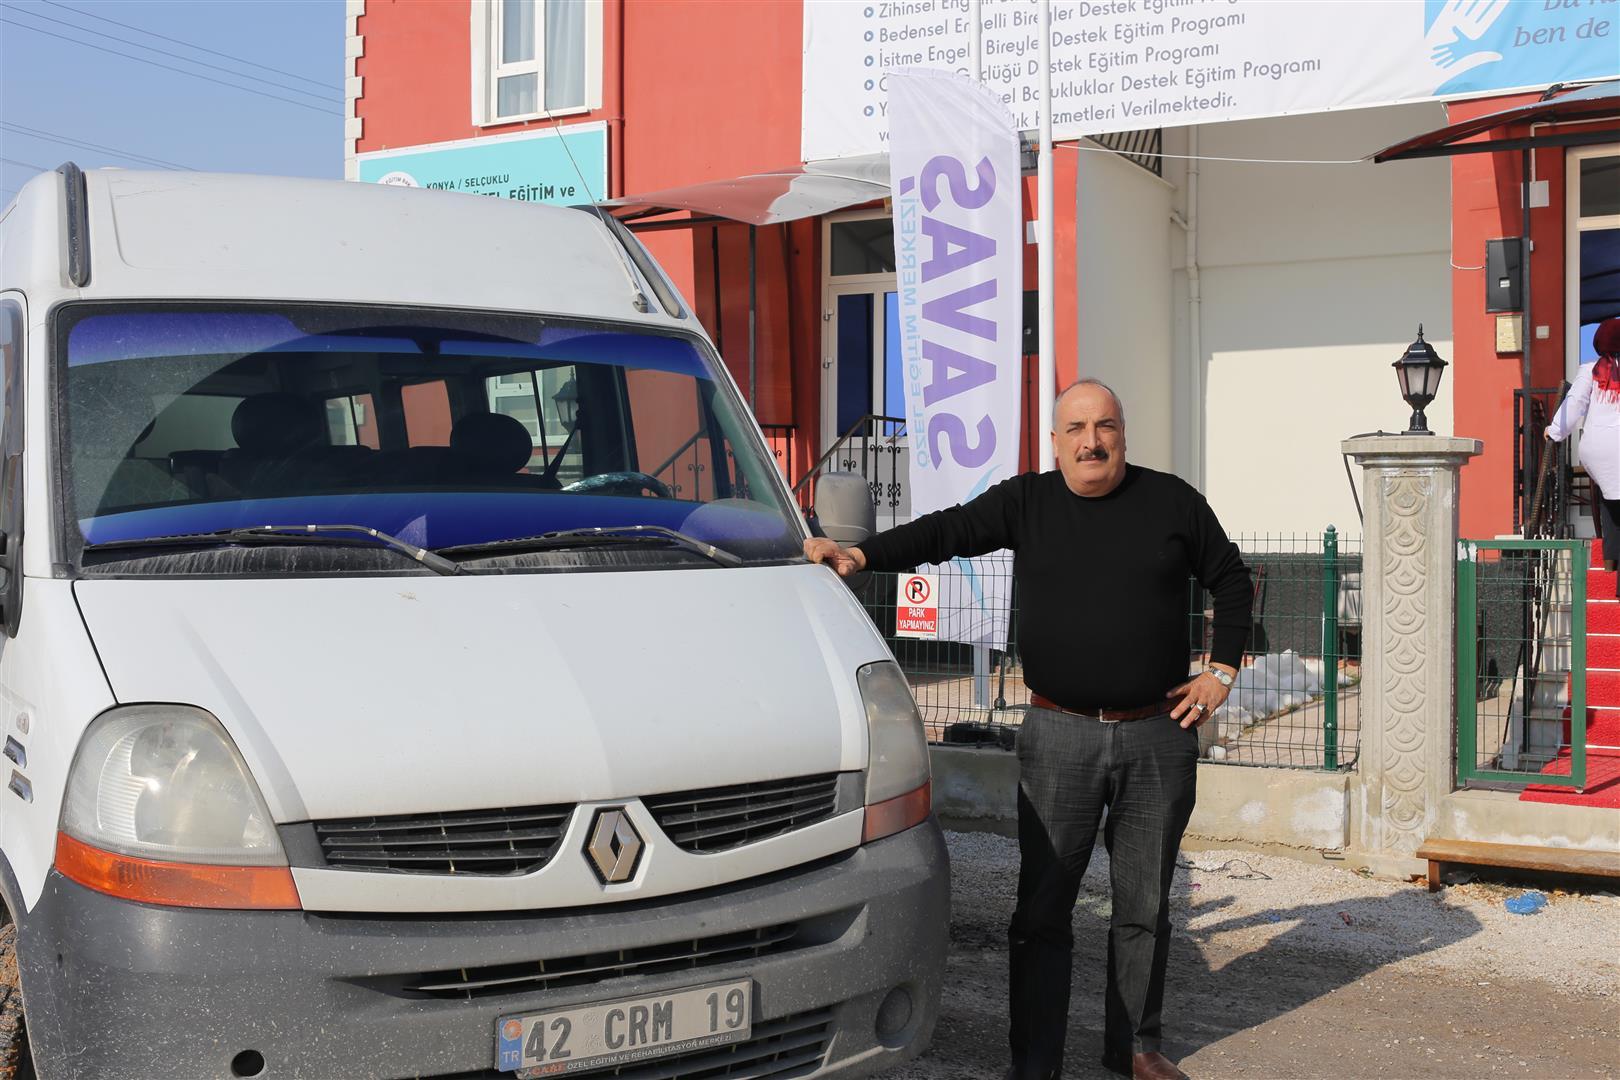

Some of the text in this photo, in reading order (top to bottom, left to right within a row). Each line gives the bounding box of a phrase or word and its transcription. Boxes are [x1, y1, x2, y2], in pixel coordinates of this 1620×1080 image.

[878, 0, 935, 18] Zihinsel
[880, 19, 948, 42] Bedensel
[955, 13, 1006, 34] Enelli
[1080, 0, 1136, 17] Destek
[1512, 17, 1610, 47] ben de
[879, 13, 1245, 67] İsitme Engel Bireyle Destek Eğitim Programı
[1028, 55, 1082, 75] Dstek
[1088, 51, 1138, 72] Eğitim
[1145, 43, 1219, 64] Programı
[1022, 78, 1114, 101] Boukluklar
[1121, 71, 1178, 92] Destek
[1185, 65, 1236, 88] Eğitim
[1243, 58, 1321, 80] Programı
[1121, 92, 1237, 117] Verilmektedir.
[426, 181, 455, 191] KONYA
[465, 174, 510, 188] SELÇUKLU
[509, 183, 554, 202] EĞİTİM
[560, 186, 575, 197] ve
[908, 607, 925, 617] PARK
[899, 619, 935, 631] YAPMAYINIZ
[524, 988, 745, 1062] 42 CRM 19
[502, 1050, 519, 1063] TR
[618, 1052, 630, 1061] VE
